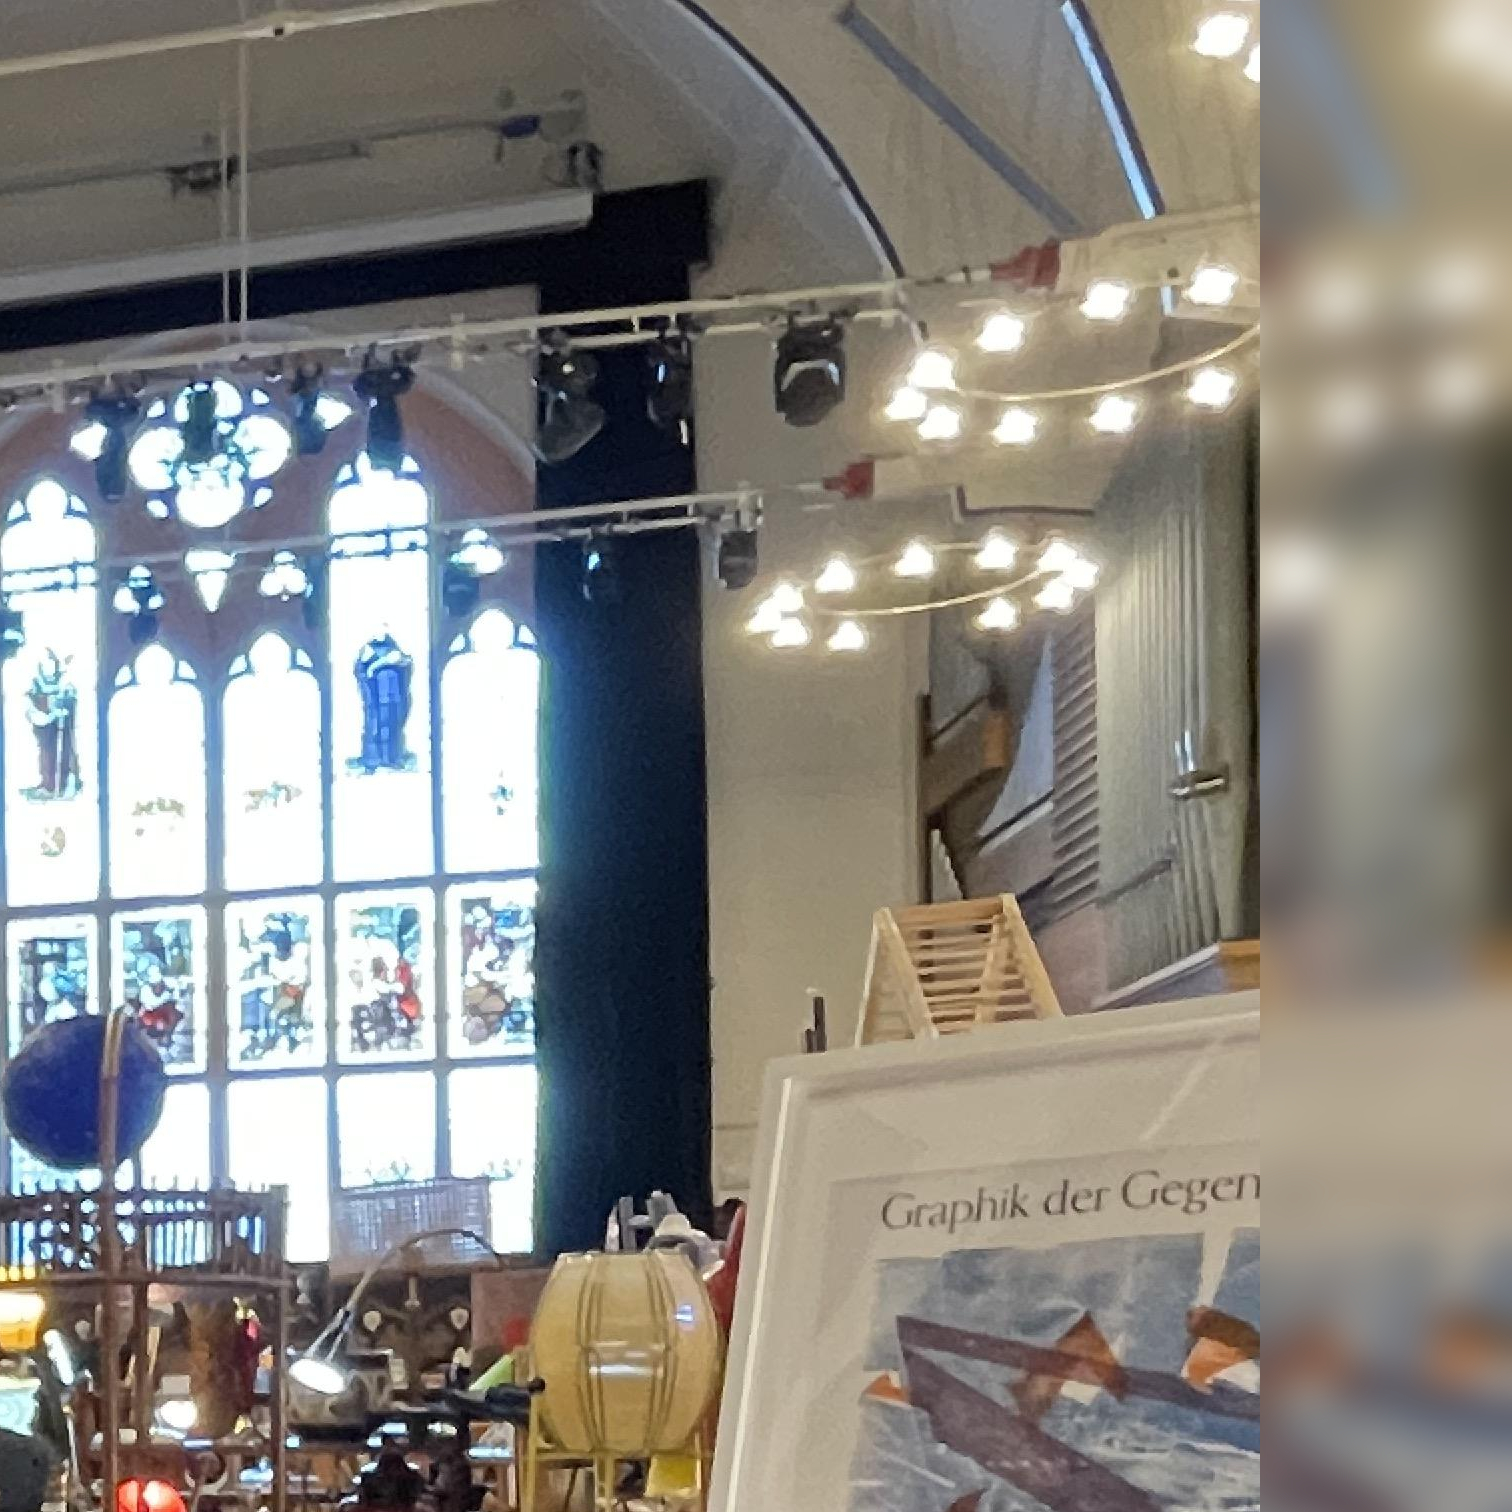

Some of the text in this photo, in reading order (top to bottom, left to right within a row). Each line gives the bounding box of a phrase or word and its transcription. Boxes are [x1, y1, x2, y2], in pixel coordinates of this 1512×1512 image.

[881, 1169, 1260, 1234] Graphik der Gegen
